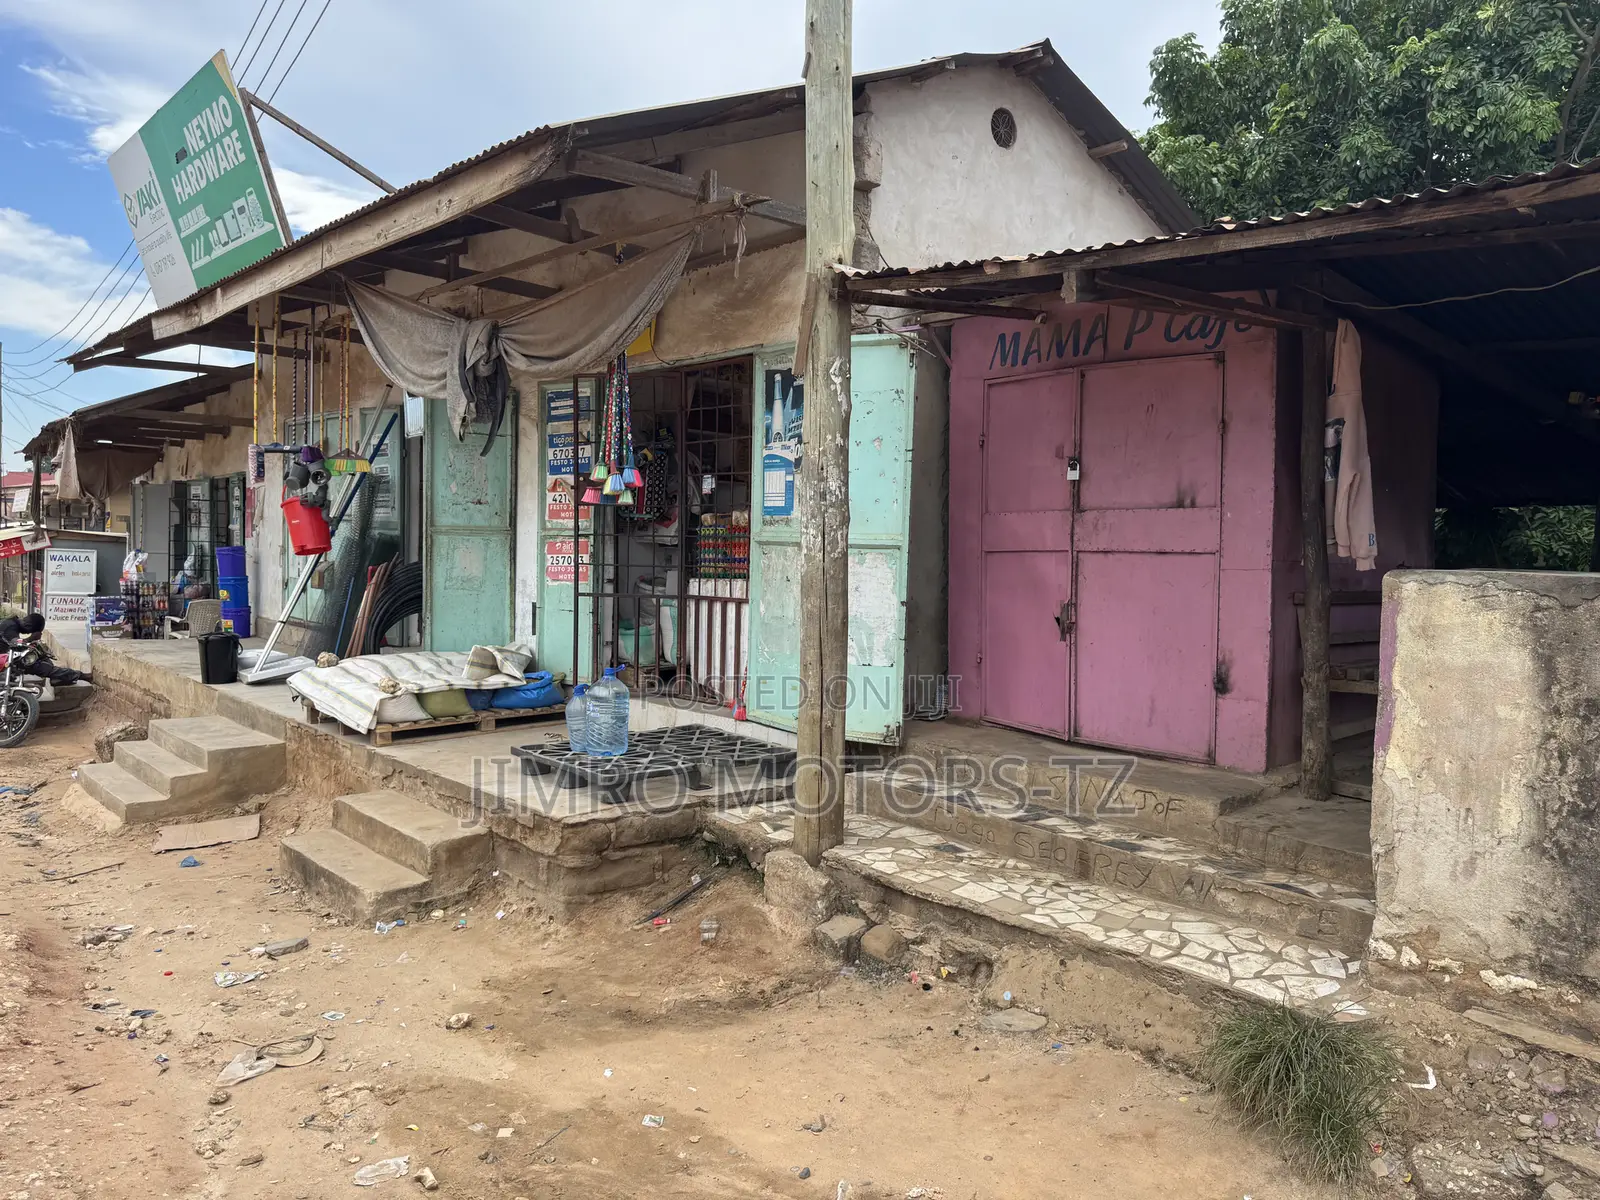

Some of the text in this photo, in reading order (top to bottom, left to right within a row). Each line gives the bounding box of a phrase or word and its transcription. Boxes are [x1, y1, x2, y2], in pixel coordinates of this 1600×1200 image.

[183, 95, 233, 157] NEYMO
[171, 129, 246, 205] HARDWARE
[989, 312, 1105, 370] MAMA
[1123, 308, 1154, 350] P
[552, 447, 585, 459] 67037
[562, 541, 575, 550] airt
[49, 554, 91, 562] WAKALA
[550, 555, 584, 565] 25703
